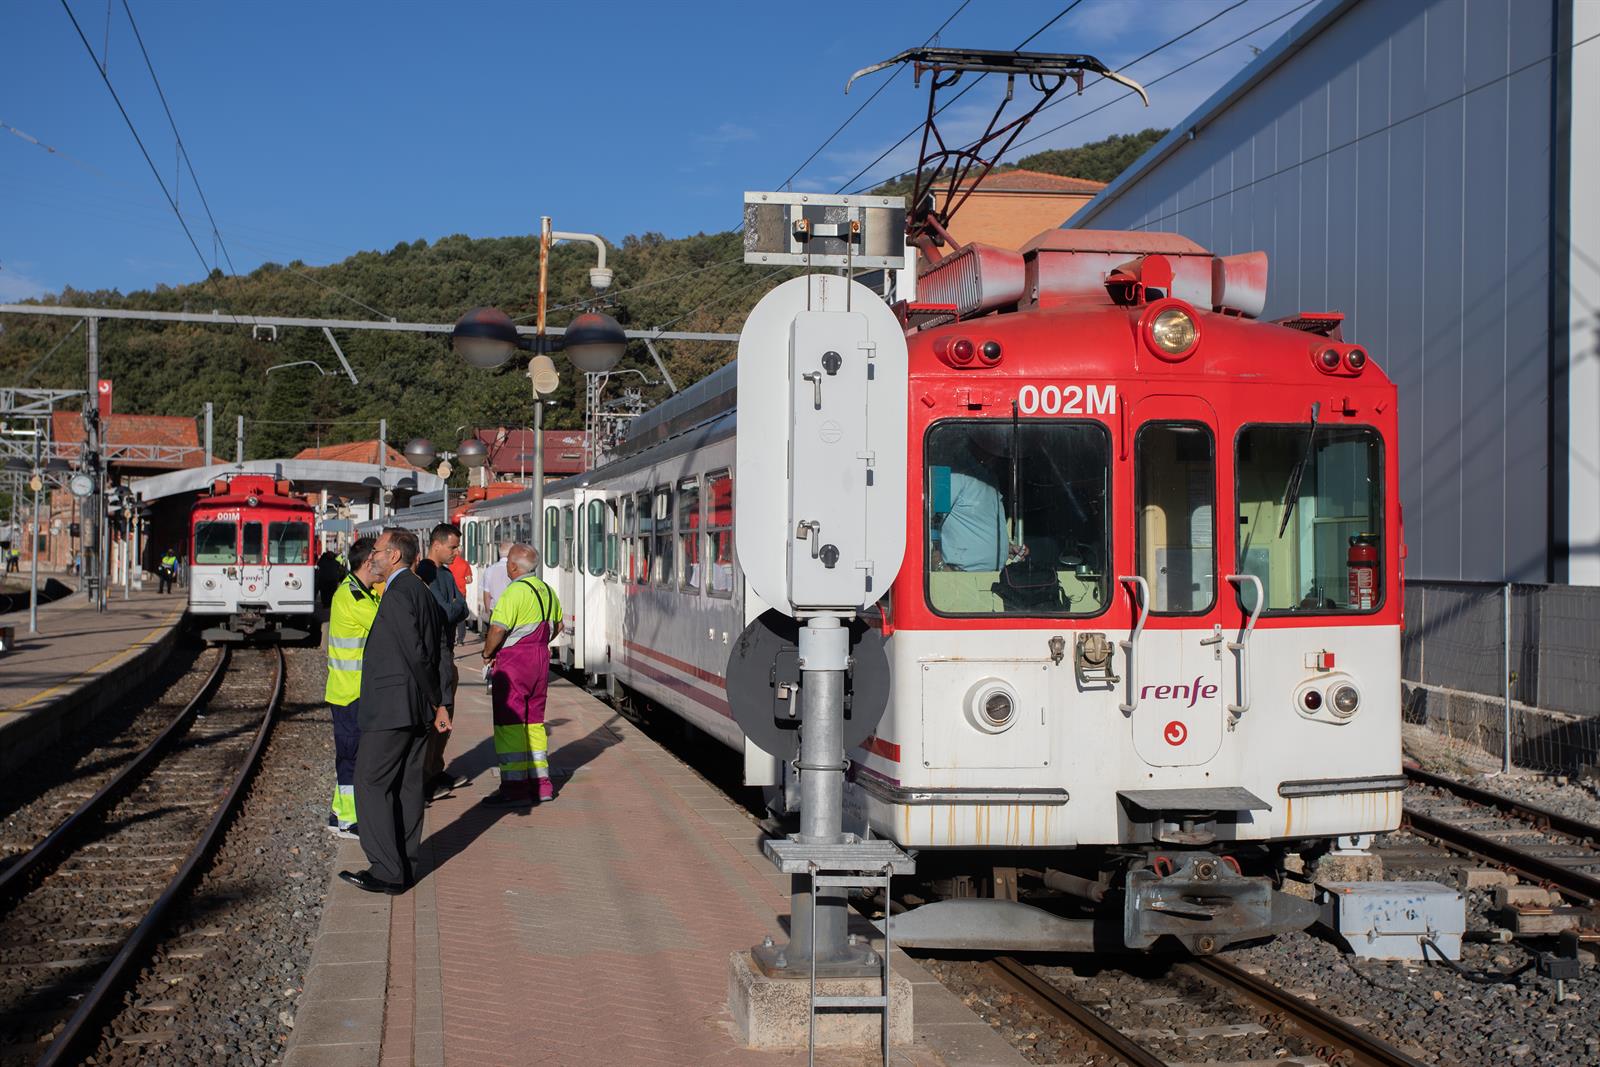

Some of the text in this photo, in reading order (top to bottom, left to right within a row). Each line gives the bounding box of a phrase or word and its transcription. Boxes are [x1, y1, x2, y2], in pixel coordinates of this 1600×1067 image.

[1018, 384, 1116, 414] 002M
[217, 512, 240, 521] 001M
[1140, 675, 1218, 708] renfe
